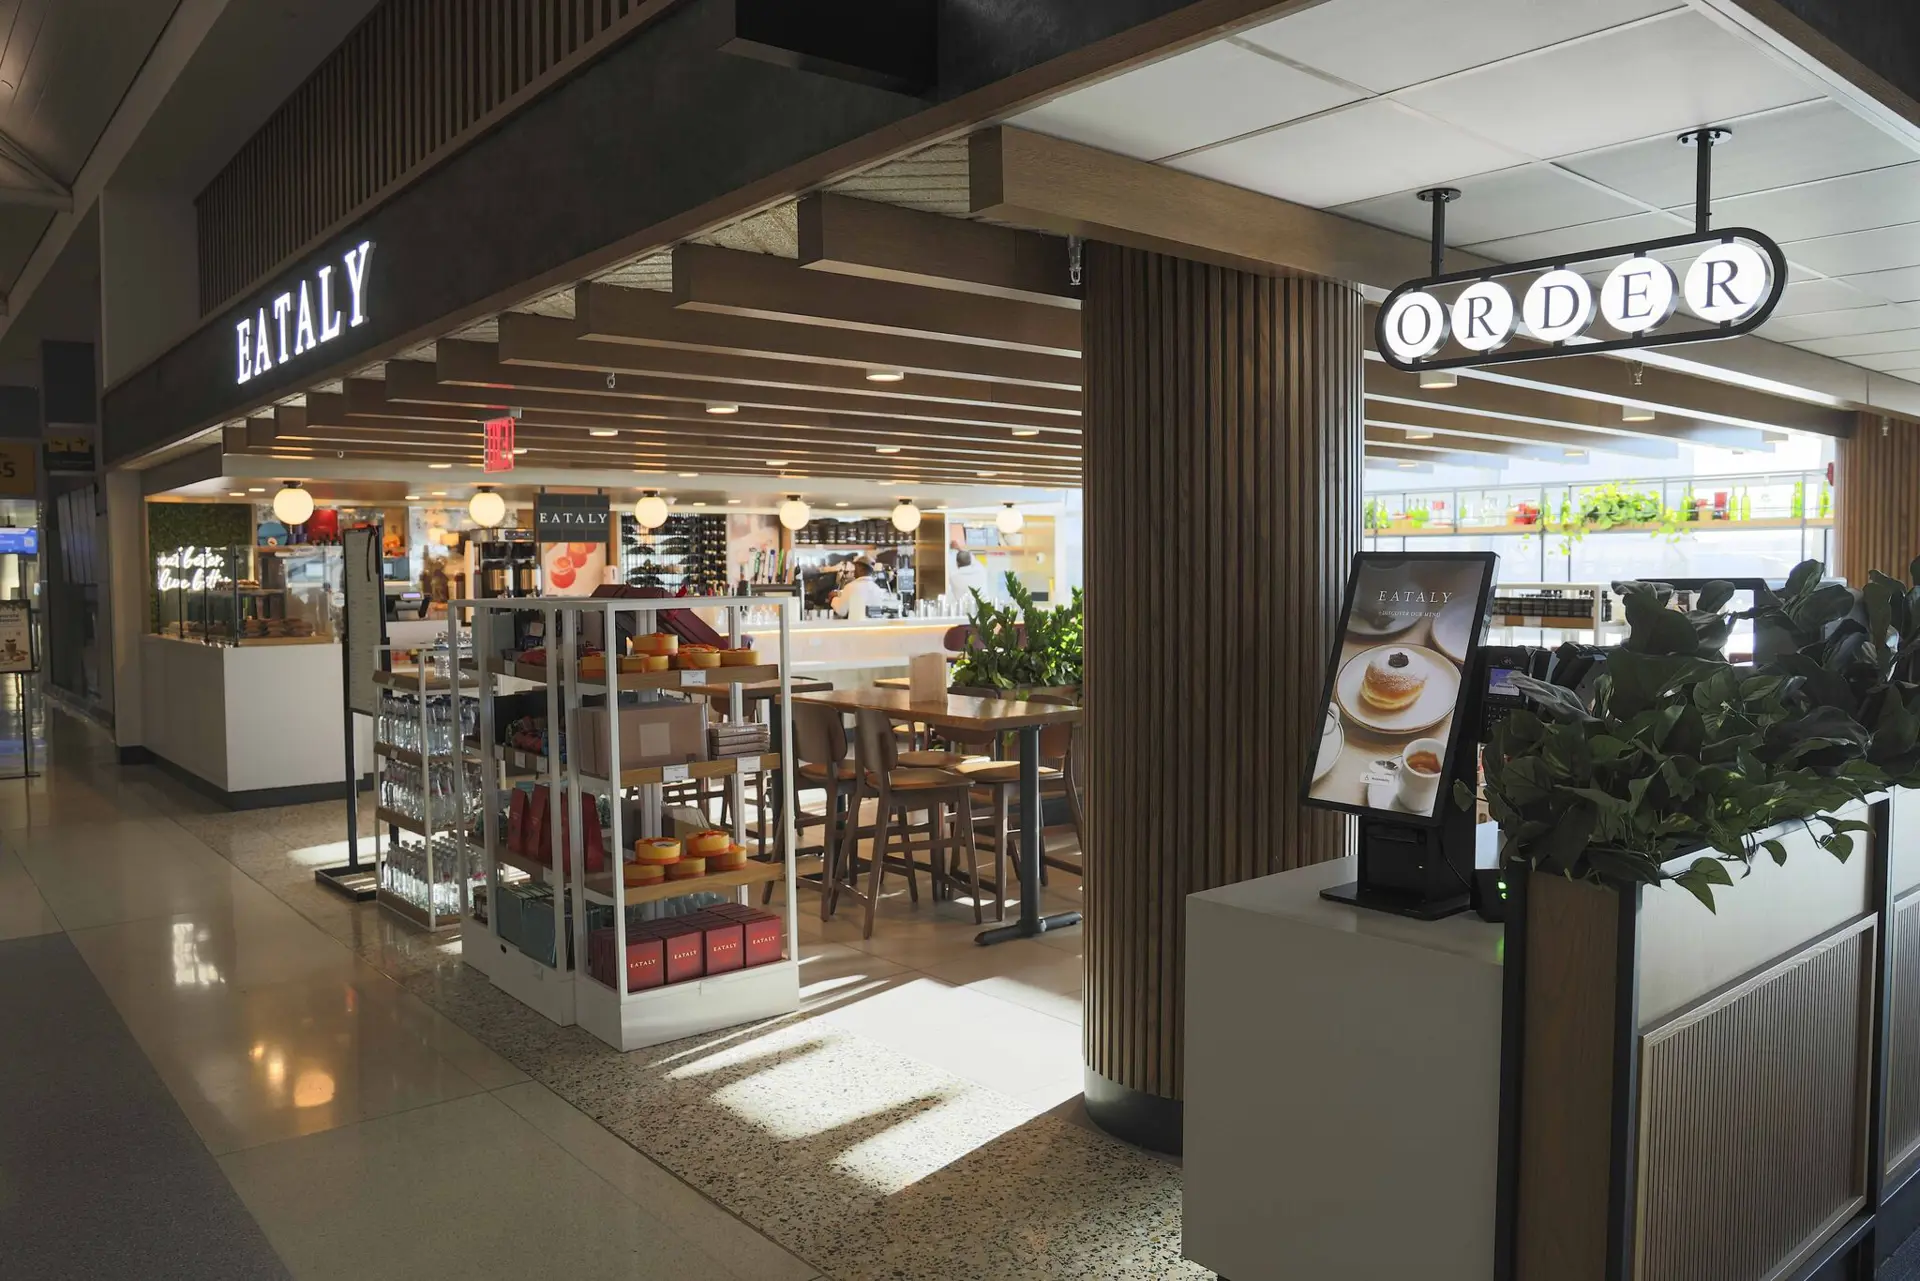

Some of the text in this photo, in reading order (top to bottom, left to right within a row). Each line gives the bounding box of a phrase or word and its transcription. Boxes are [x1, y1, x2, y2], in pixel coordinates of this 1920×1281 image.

[1397, 259, 1745, 347] ORDER
[236, 240, 373, 385] EATALY
[539, 512, 607, 524] EATALY
[1378, 590, 1452, 603] EATALY
[752, 936, 776, 945] EATALY
[713, 943, 737, 952] EATALY
[674, 950, 698, 959] EATALY
[630, 959, 656, 968] EATALY
